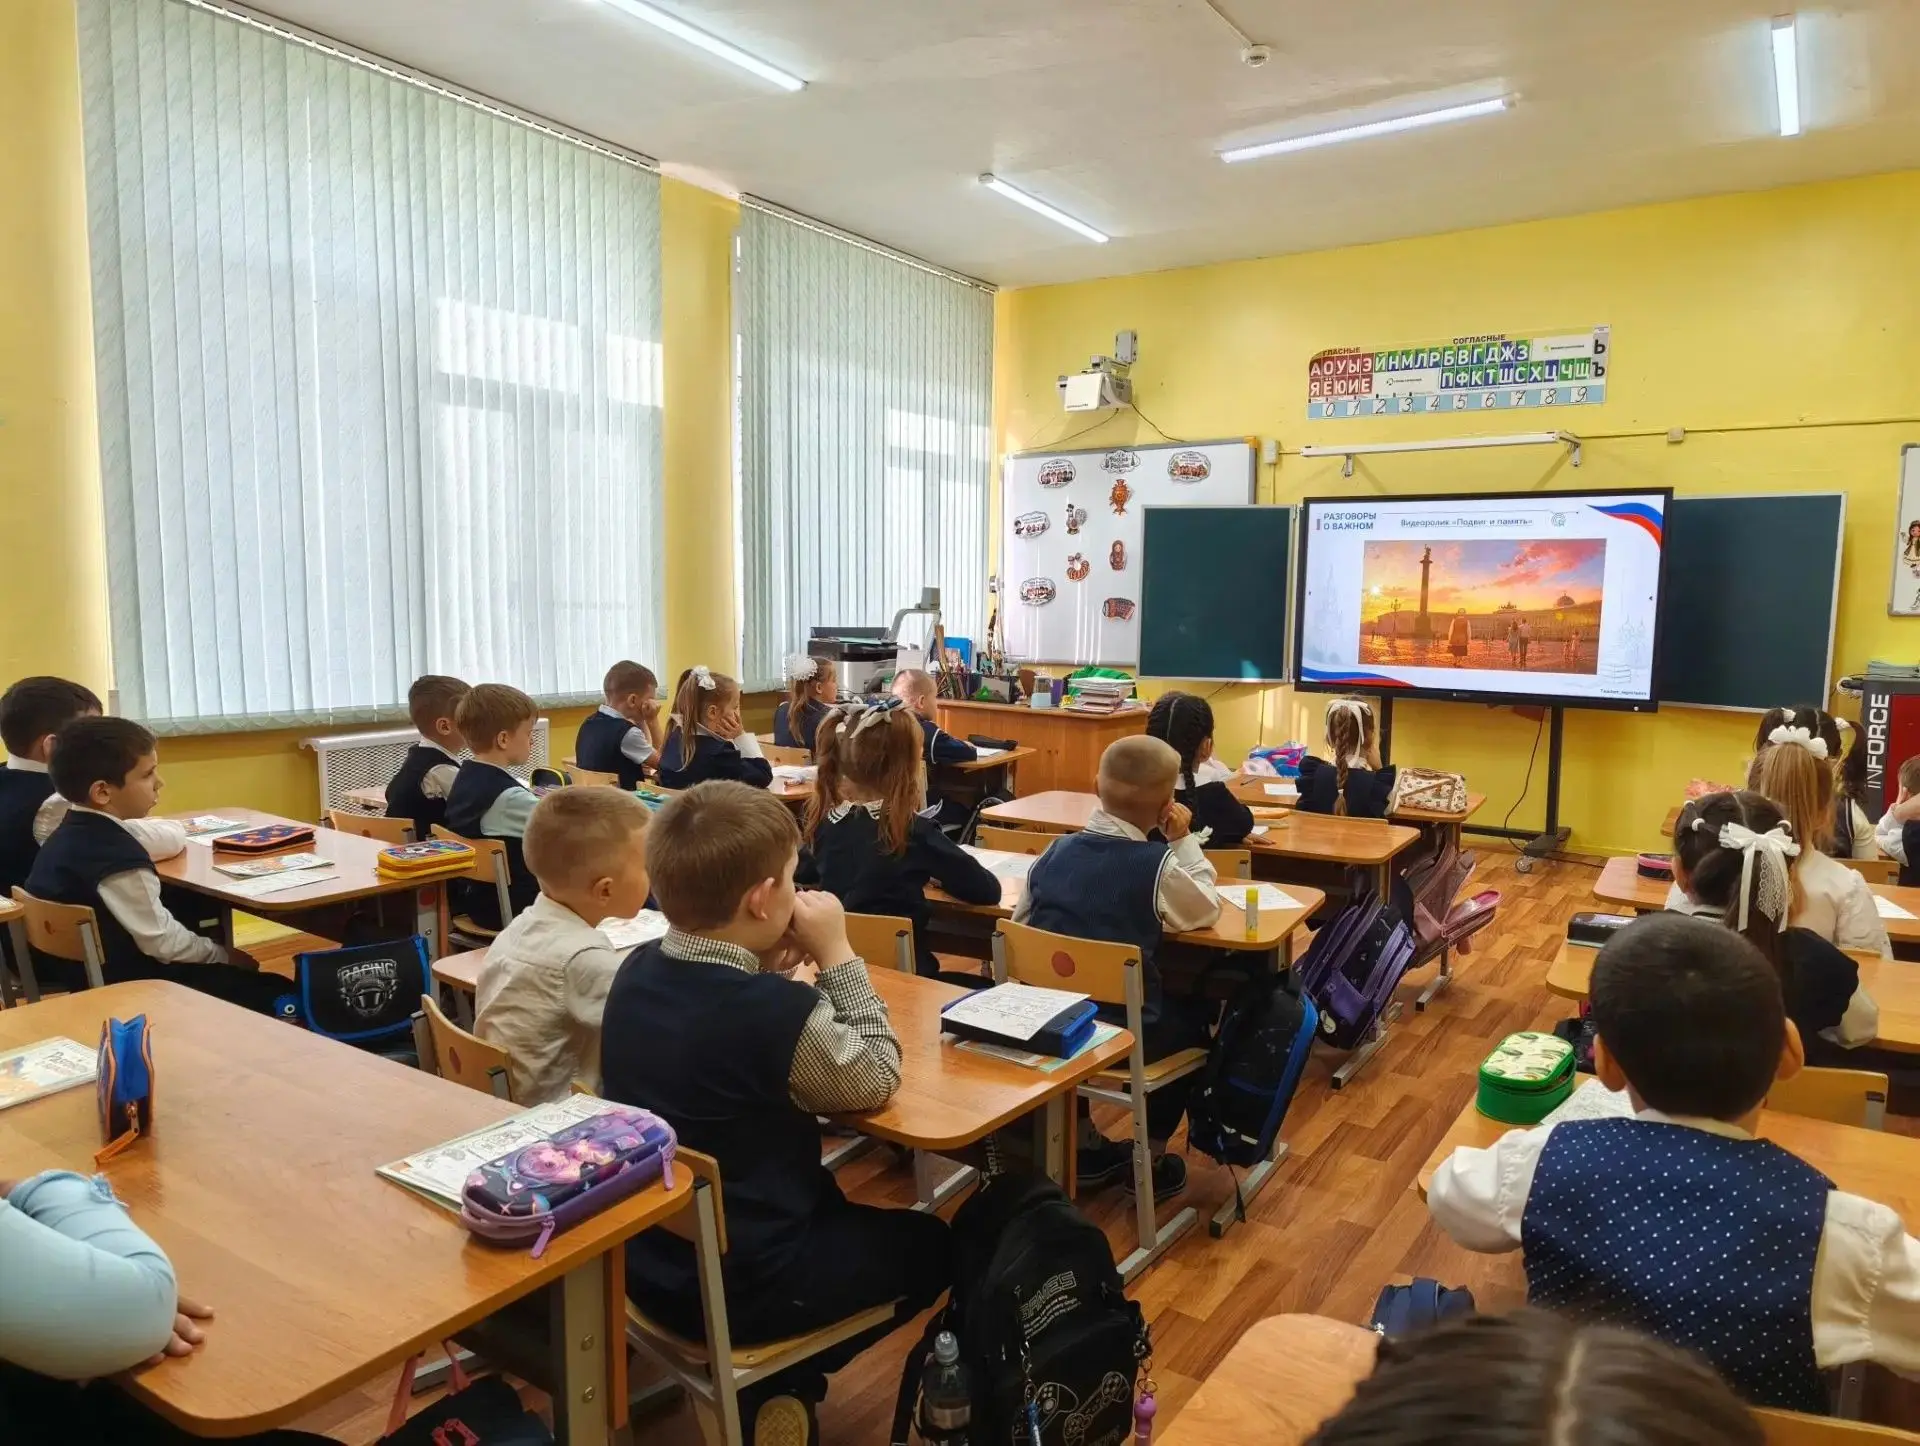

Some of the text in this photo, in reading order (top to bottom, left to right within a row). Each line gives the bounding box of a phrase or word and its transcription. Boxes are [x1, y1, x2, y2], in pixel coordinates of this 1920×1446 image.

[1453, 334, 1506, 345] СОГЛАСНЫЕ
[1322, 347, 1360, 356] ГЛАСНЫЕ
[1326, 402, 1336, 417] 0
[1375, 398, 1387, 414] 2
[1402, 397, 1413, 412] 3
[1430, 396, 1440, 411] 4
[1456, 394, 1467, 409] 5
[1485, 392, 1496, 408] 6
[1515, 390, 1526, 406] 7
[1544, 388, 1557, 404] 8
[1576, 386, 1588, 403] 9
[1323, 512, 1377, 520] РАЗГОВОРЫ
[1323, 522, 1374, 530] О ВАЖНОМ
[1401, 519, 1449, 528] Видеоролик
[341, 962, 396, 984] RACING
